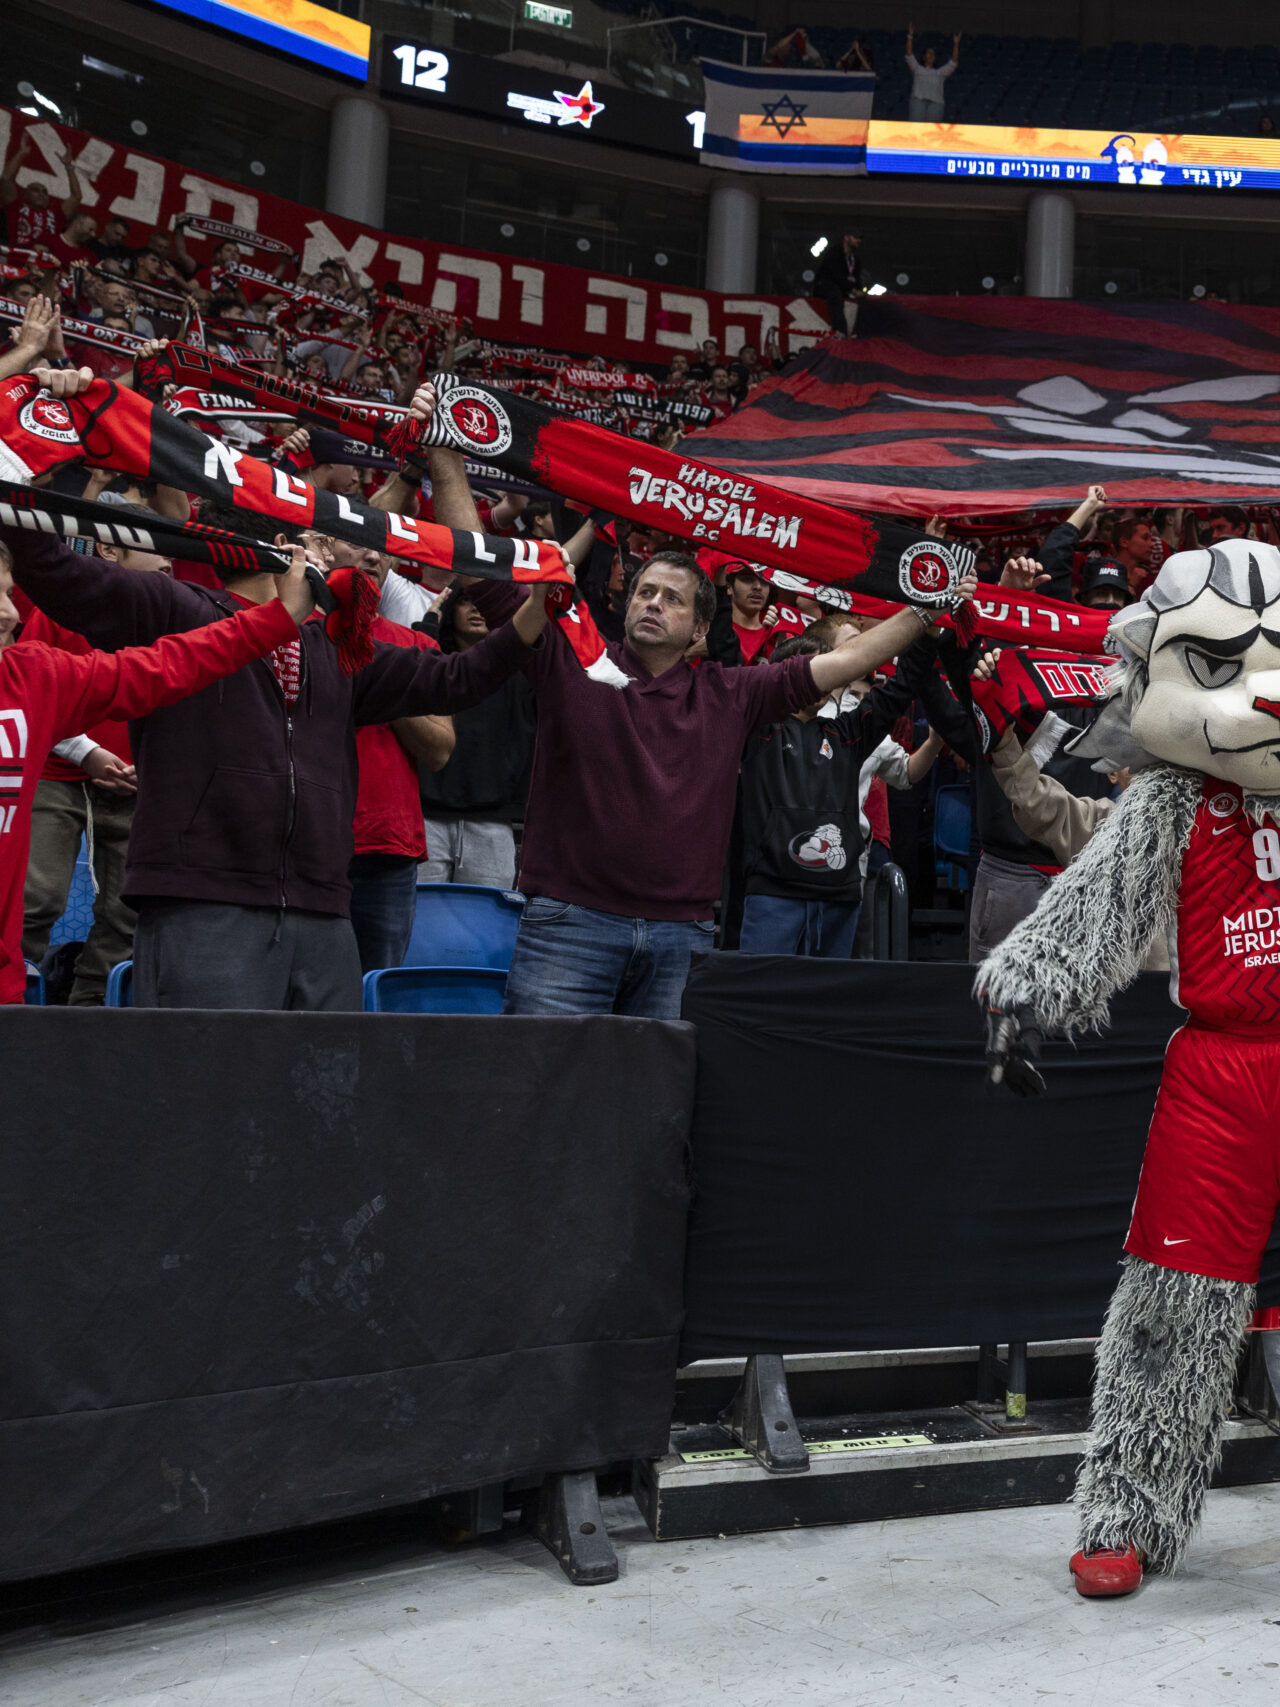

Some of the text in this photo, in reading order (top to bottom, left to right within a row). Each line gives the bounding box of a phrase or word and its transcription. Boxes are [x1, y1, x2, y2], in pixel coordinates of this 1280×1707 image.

[392, 44, 449, 93] 12
[947, 158, 1091, 180] מים מינרליים טבעיים
[1182, 168, 1243, 189] עין גדי
[302, 219, 546, 327] והיא
[93, 328, 118, 342] ON
[566, 367, 627, 385] LIVERPOOL
[446, 388, 506, 421] הפועל ירושלים
[445, 417, 464, 445] HAPOEL
[463, 440, 501, 454] JERUSALEM
[677, 462, 757, 502] HAPOEL
[628, 465, 805, 549] JERUSALEM
